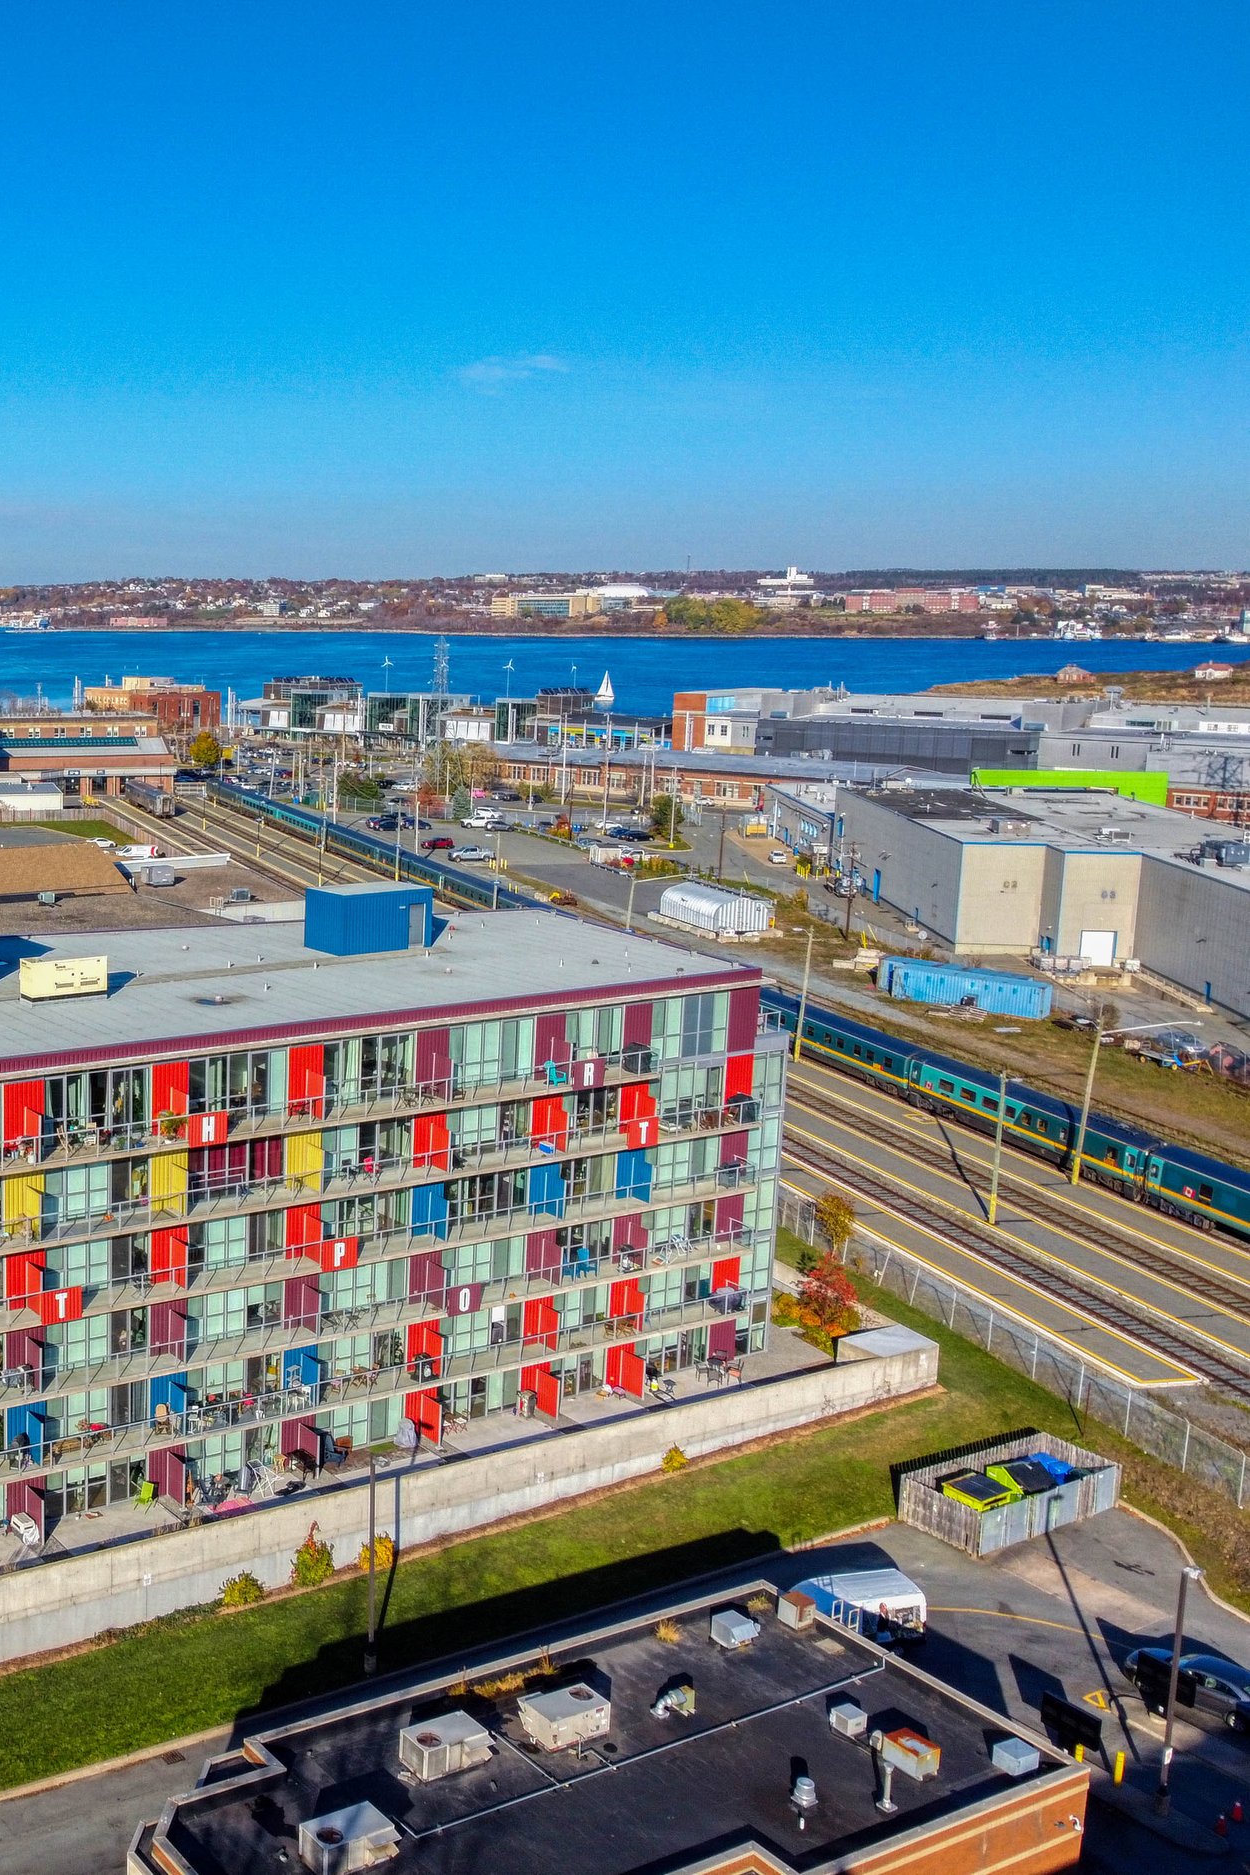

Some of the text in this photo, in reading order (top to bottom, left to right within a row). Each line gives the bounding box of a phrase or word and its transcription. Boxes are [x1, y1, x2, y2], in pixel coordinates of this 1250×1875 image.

[583, 1062, 595, 1087] R
[201, 1116, 215, 1142] H
[639, 1121, 649, 1144] T
[334, 1242, 345, 1267] P
[55, 1292, 68, 1319] T
[459, 1288, 471, 1312] O
